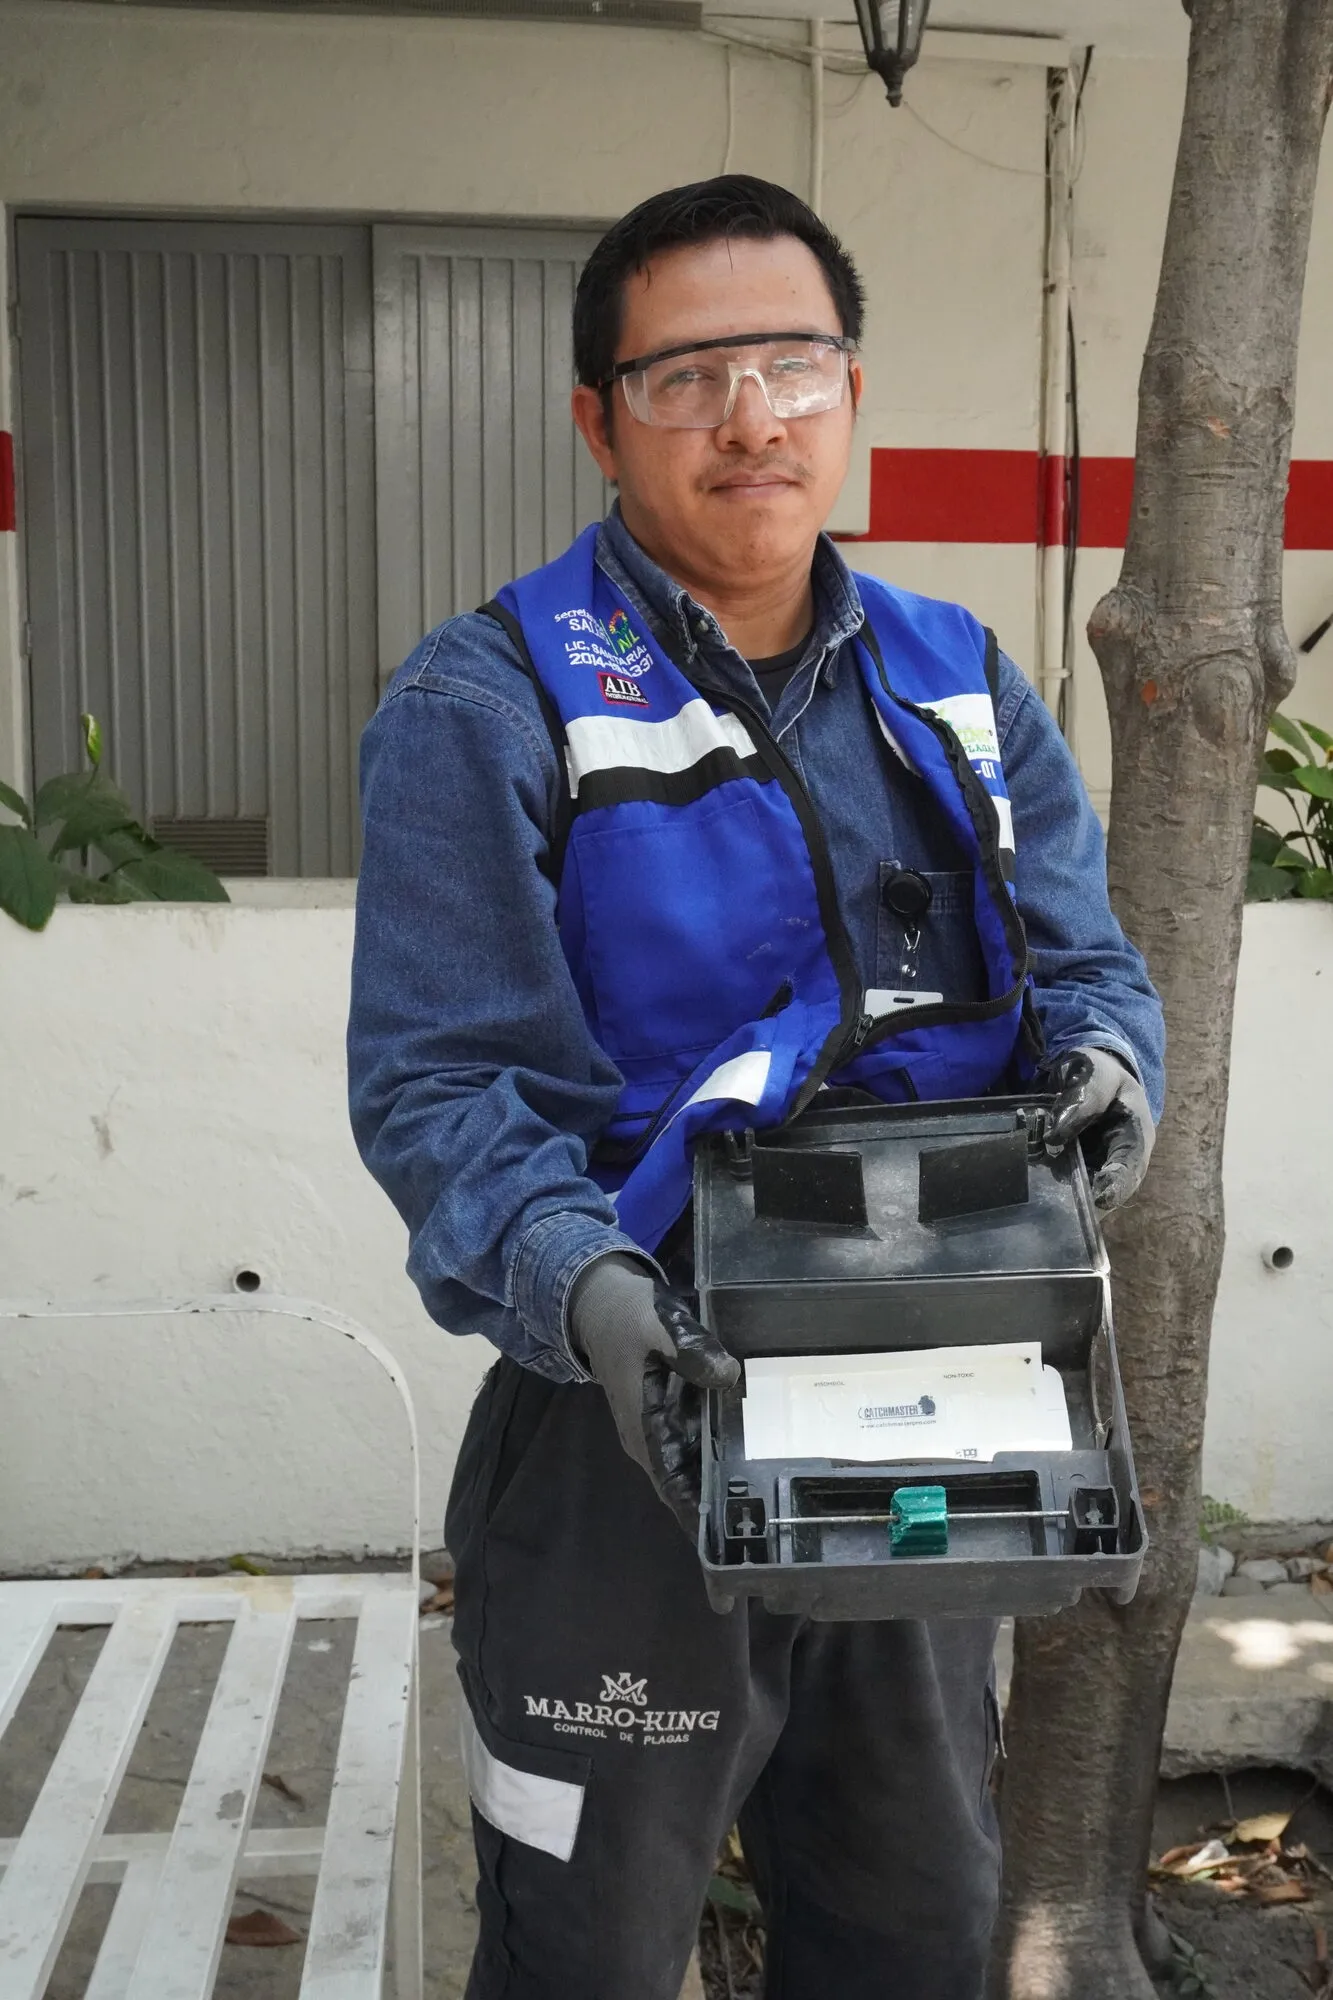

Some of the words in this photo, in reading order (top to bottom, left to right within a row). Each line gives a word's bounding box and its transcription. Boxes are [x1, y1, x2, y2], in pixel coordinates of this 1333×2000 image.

[604, 675, 641, 697] AIB
[864, 1404, 919, 1418] CATCHMASTER
[523, 1695, 721, 1732] MARRO-KING
[553, 1722, 608, 1739] CONTROL
[619, 1731, 634, 1744] DE
[643, 1733, 690, 1745] PLAGAS
